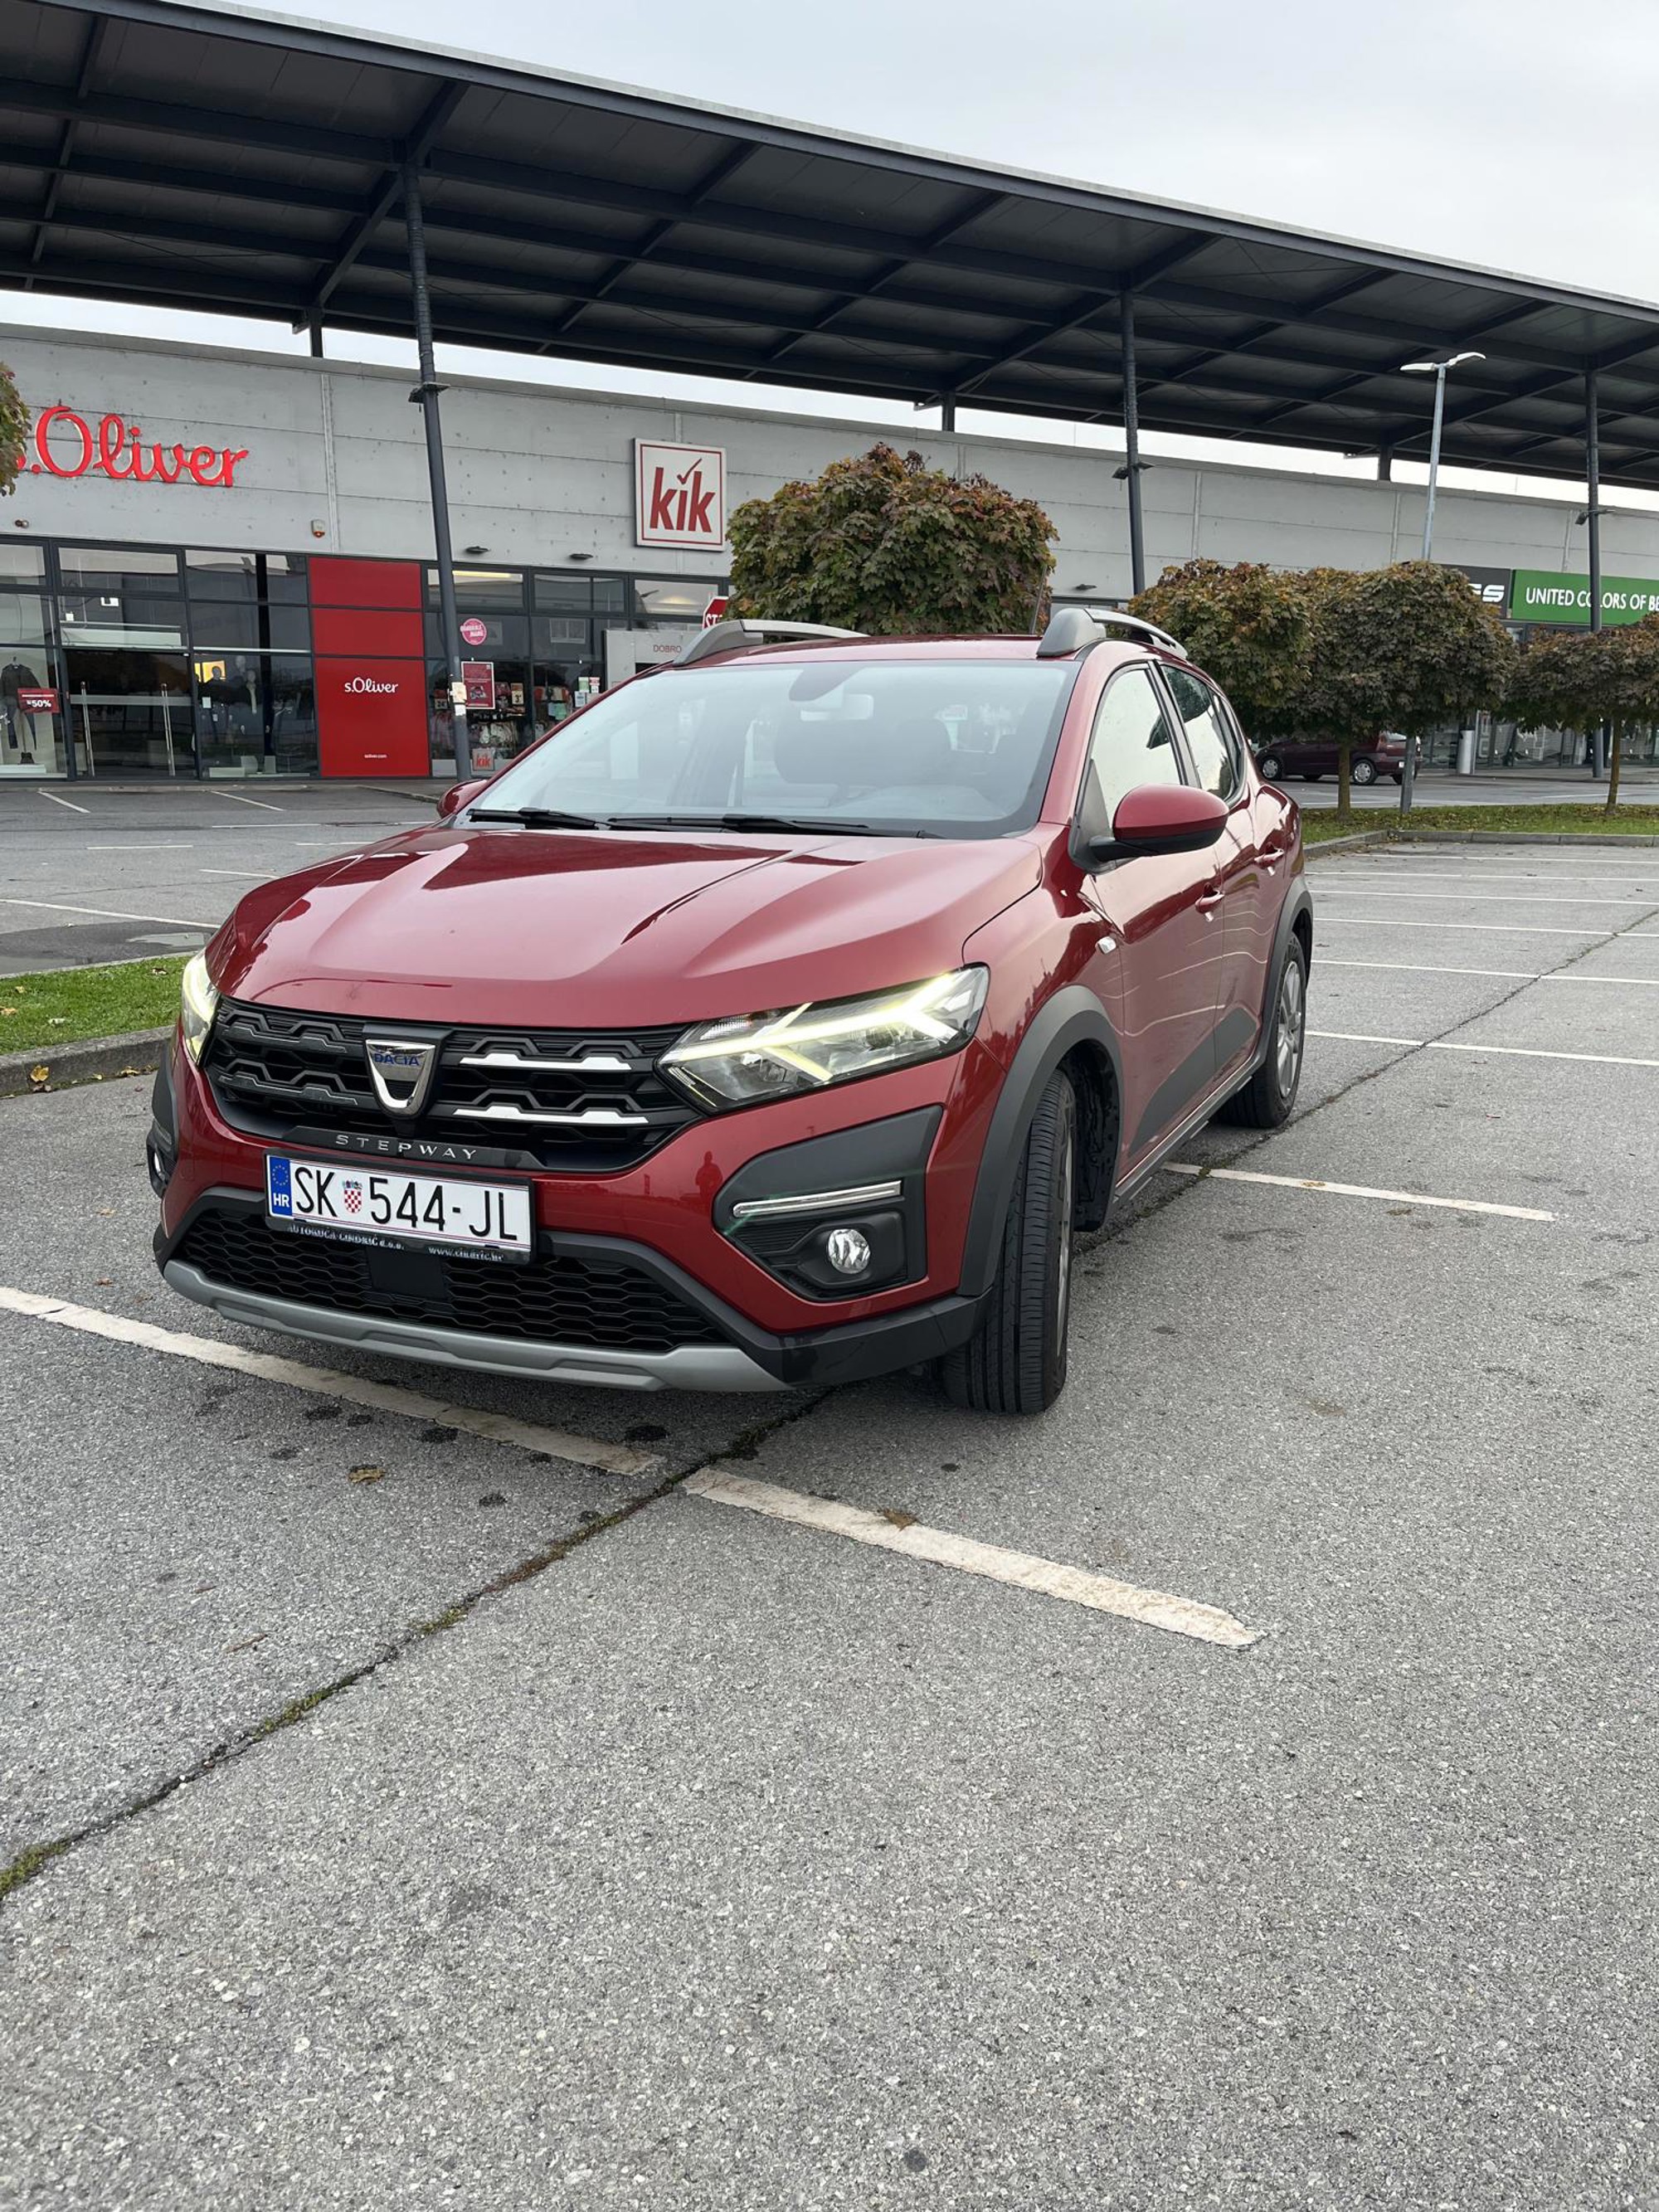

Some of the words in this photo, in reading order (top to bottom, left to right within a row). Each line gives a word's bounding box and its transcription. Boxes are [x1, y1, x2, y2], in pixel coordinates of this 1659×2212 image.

[17, 406, 249, 487] .Oliver
[649, 458, 716, 532] kik
[1525, 587, 1574, 606] UNITED
[1577, 590, 1627, 610] COORS
[1629, 593, 1647, 610] OF
[706, 614, 722, 627] ST
[653, 644, 682, 653] DOBRO
[344, 677, 398, 693] s.Oliver
[374, 1053, 420, 1067] DACIA
[335, 1134, 476, 1159] STEPWAY
[273, 1193, 290, 1208] HR
[294, 1166, 338, 1218] SK
